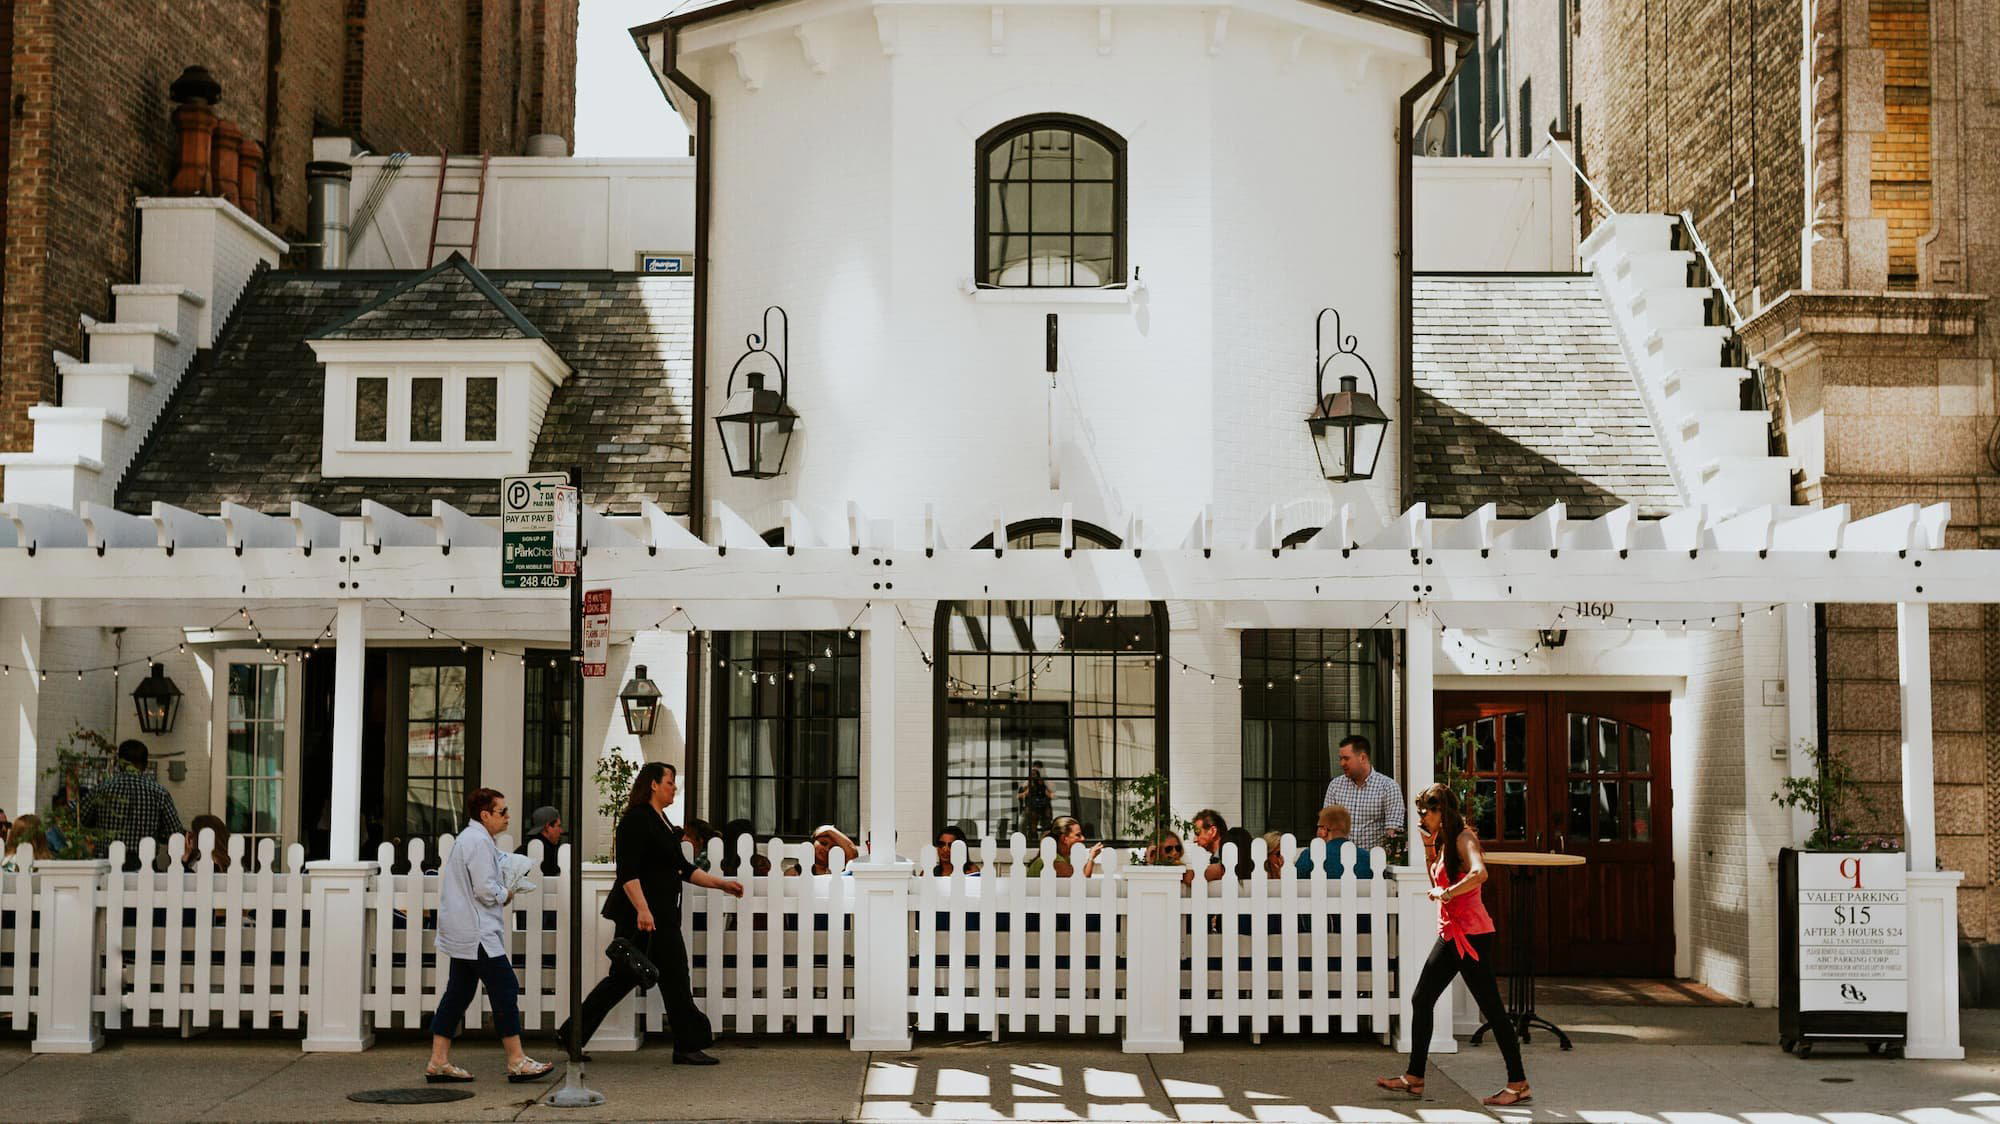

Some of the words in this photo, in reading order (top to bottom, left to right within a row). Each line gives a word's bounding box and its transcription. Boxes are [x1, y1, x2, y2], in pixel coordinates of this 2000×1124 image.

[514, 486, 525, 504] P
[540, 492, 544, 500] 7
[545, 492, 554, 500] DA
[505, 515, 519, 523] PAY
[531, 514, 546, 522] PAY
[514, 546, 554, 557] ParkChica
[520, 576, 538, 587] 248
[540, 576, 560, 587] 405
[1576, 601, 1614, 617] 1160
[1806, 892, 1846, 902] VALET
[1847, 892, 1899, 902] PARKING
[1834, 904, 1871, 926] $15
[1803, 927, 1837, 937] AFTER
[1839, 928, 1845, 937] 3
[1847, 927, 1884, 937] HOURS
[1886, 927, 1903, 937] $24
